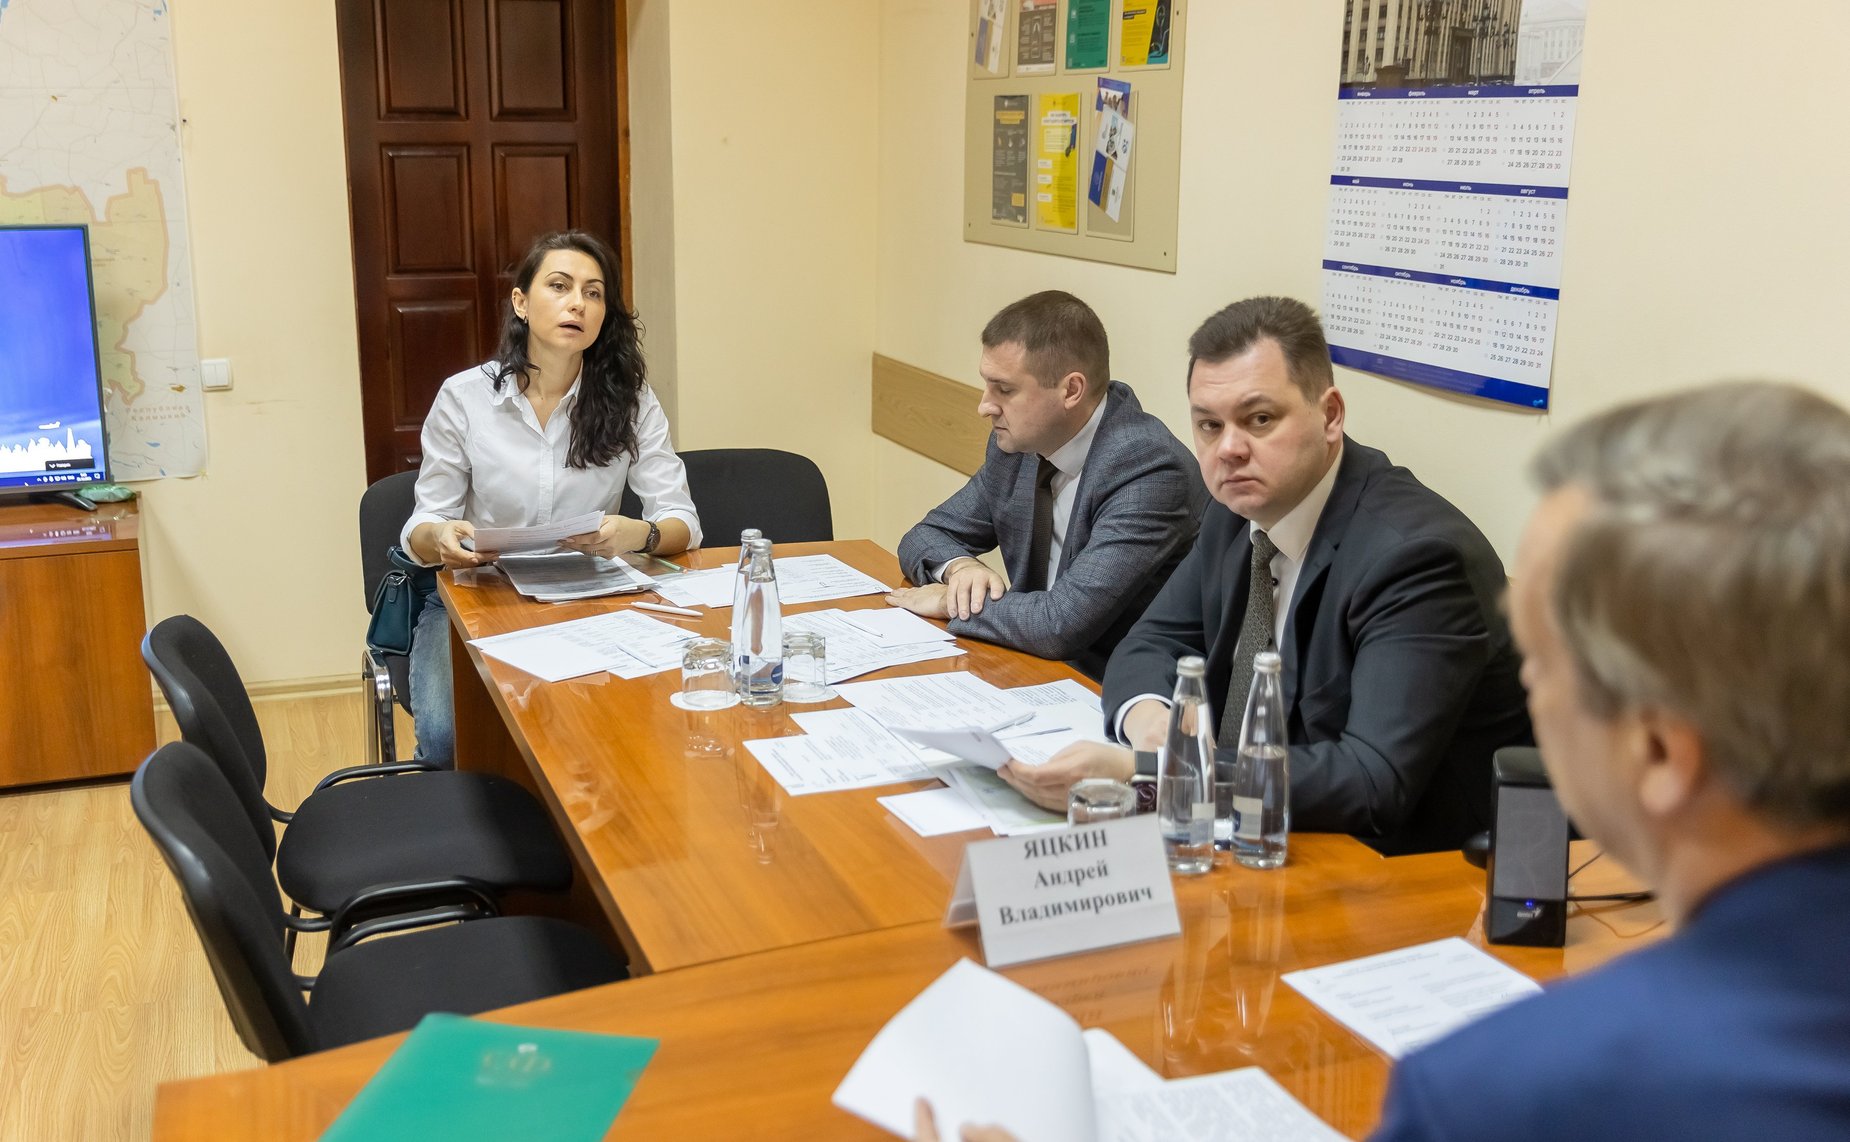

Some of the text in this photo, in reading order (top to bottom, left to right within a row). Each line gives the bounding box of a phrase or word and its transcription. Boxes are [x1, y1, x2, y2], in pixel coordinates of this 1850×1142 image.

[1023, 829, 1108, 860] ЯЦКИН
[1034, 860, 1110, 889] Андрей
[998, 886, 1153, 926] Владимирович
